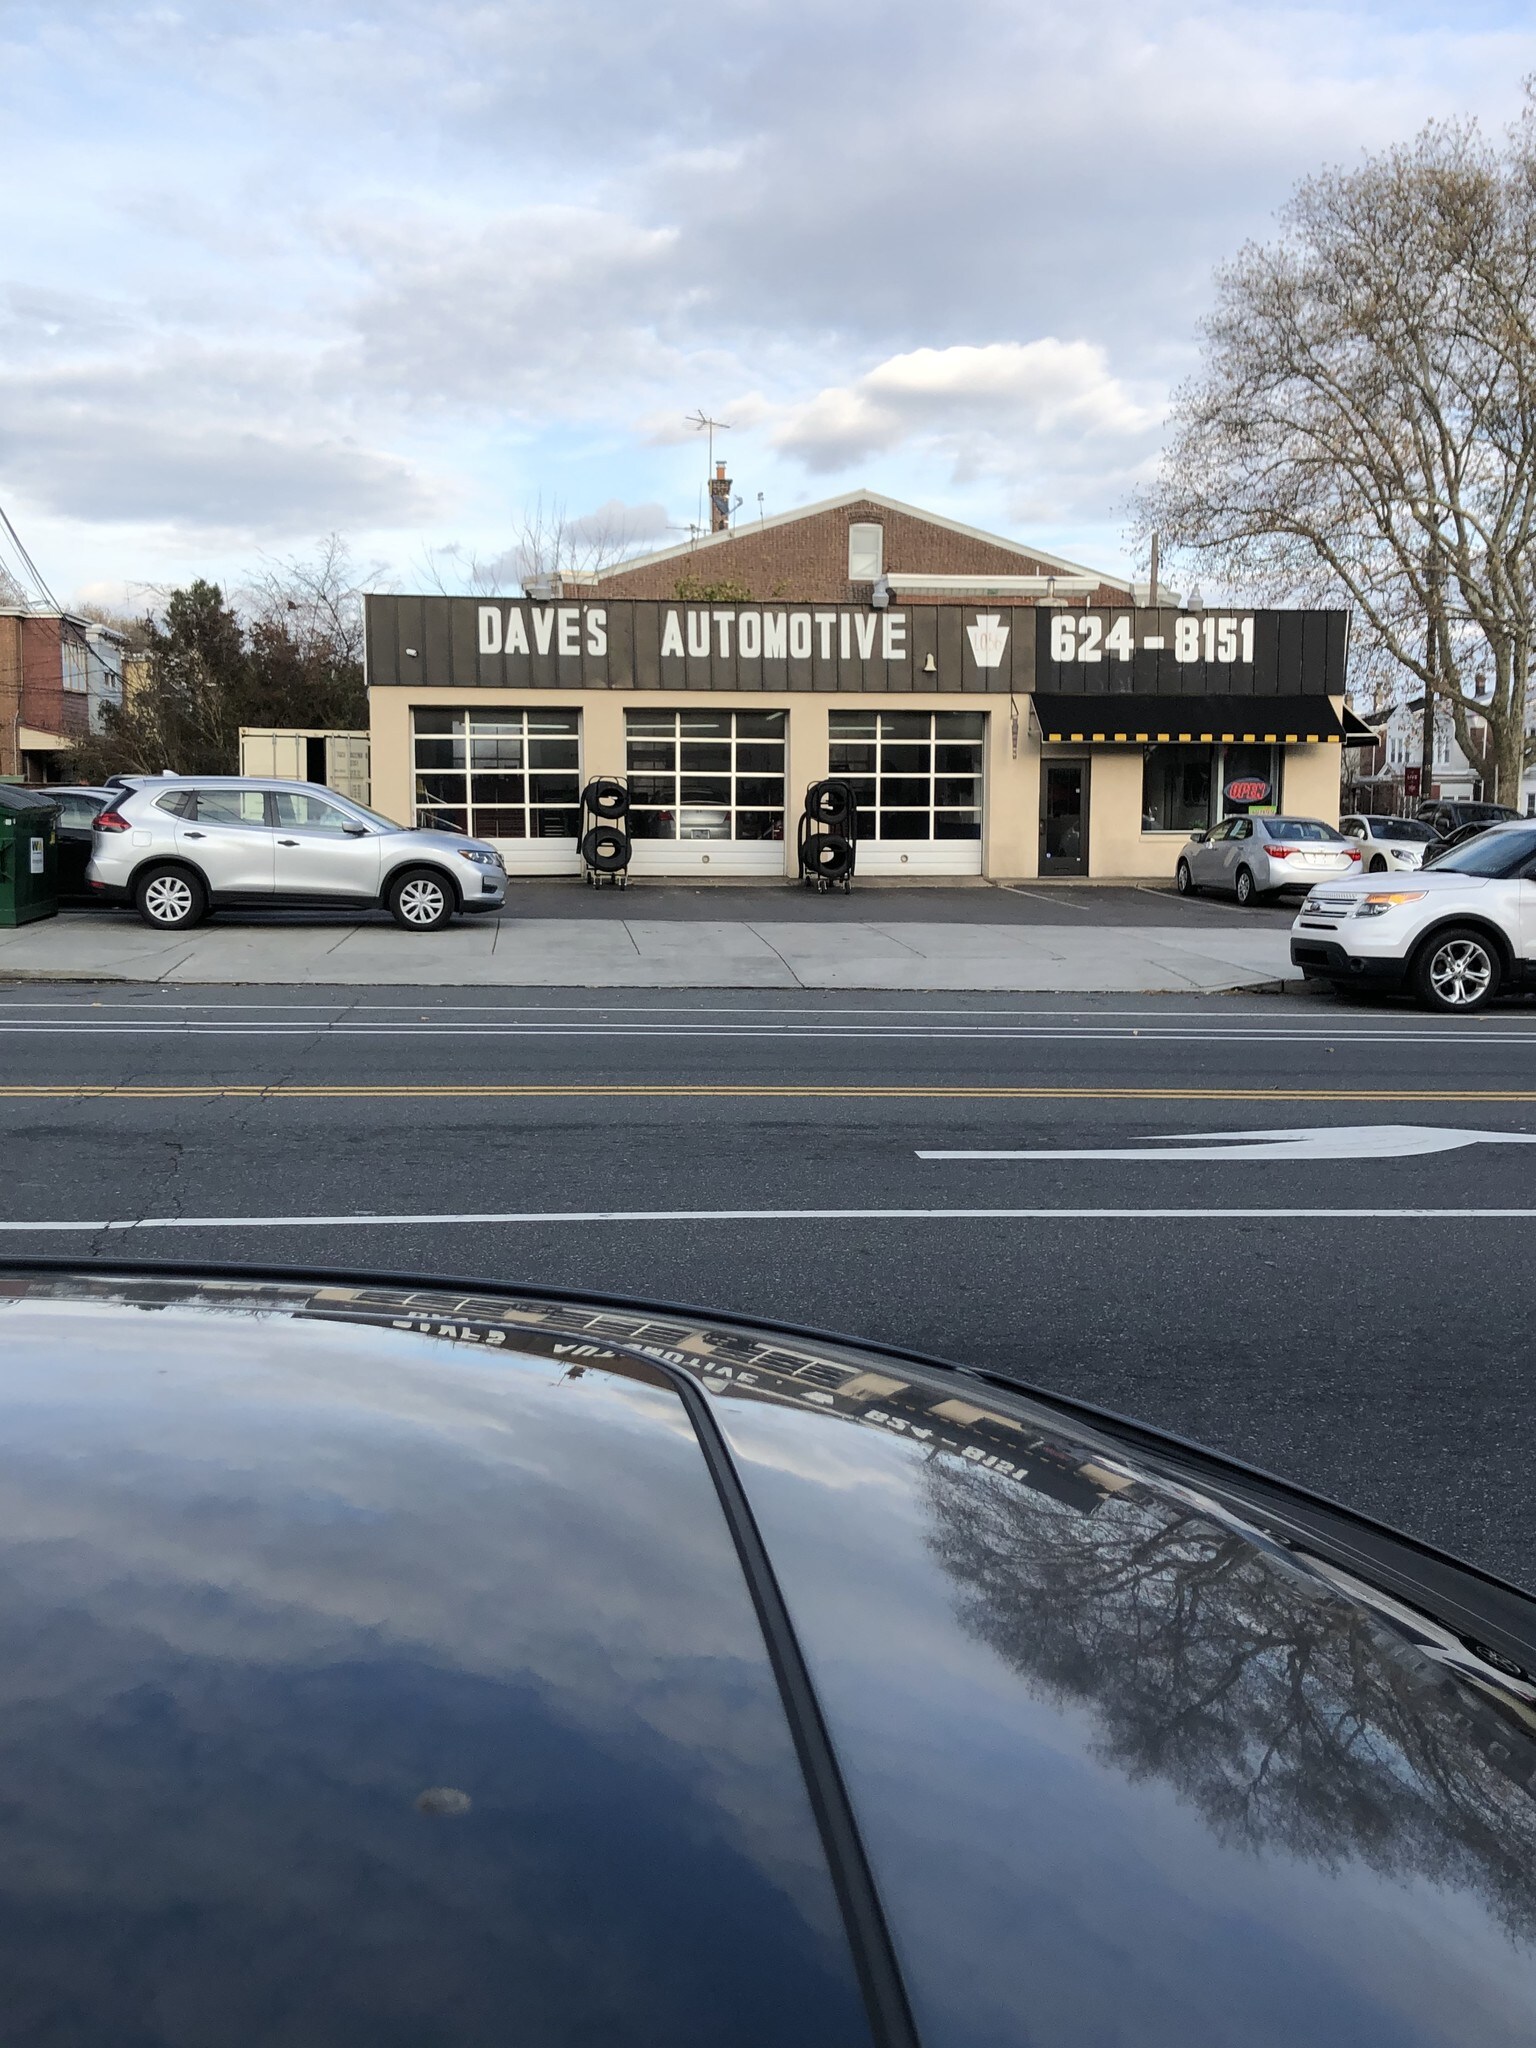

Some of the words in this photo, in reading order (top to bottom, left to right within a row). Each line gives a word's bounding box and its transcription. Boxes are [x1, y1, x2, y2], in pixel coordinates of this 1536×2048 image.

[478, 605, 607, 656] DAVE'S
[661, 609, 906, 660] AUTOMOTIVE
[1230, 782, 1265, 800] OPEN
